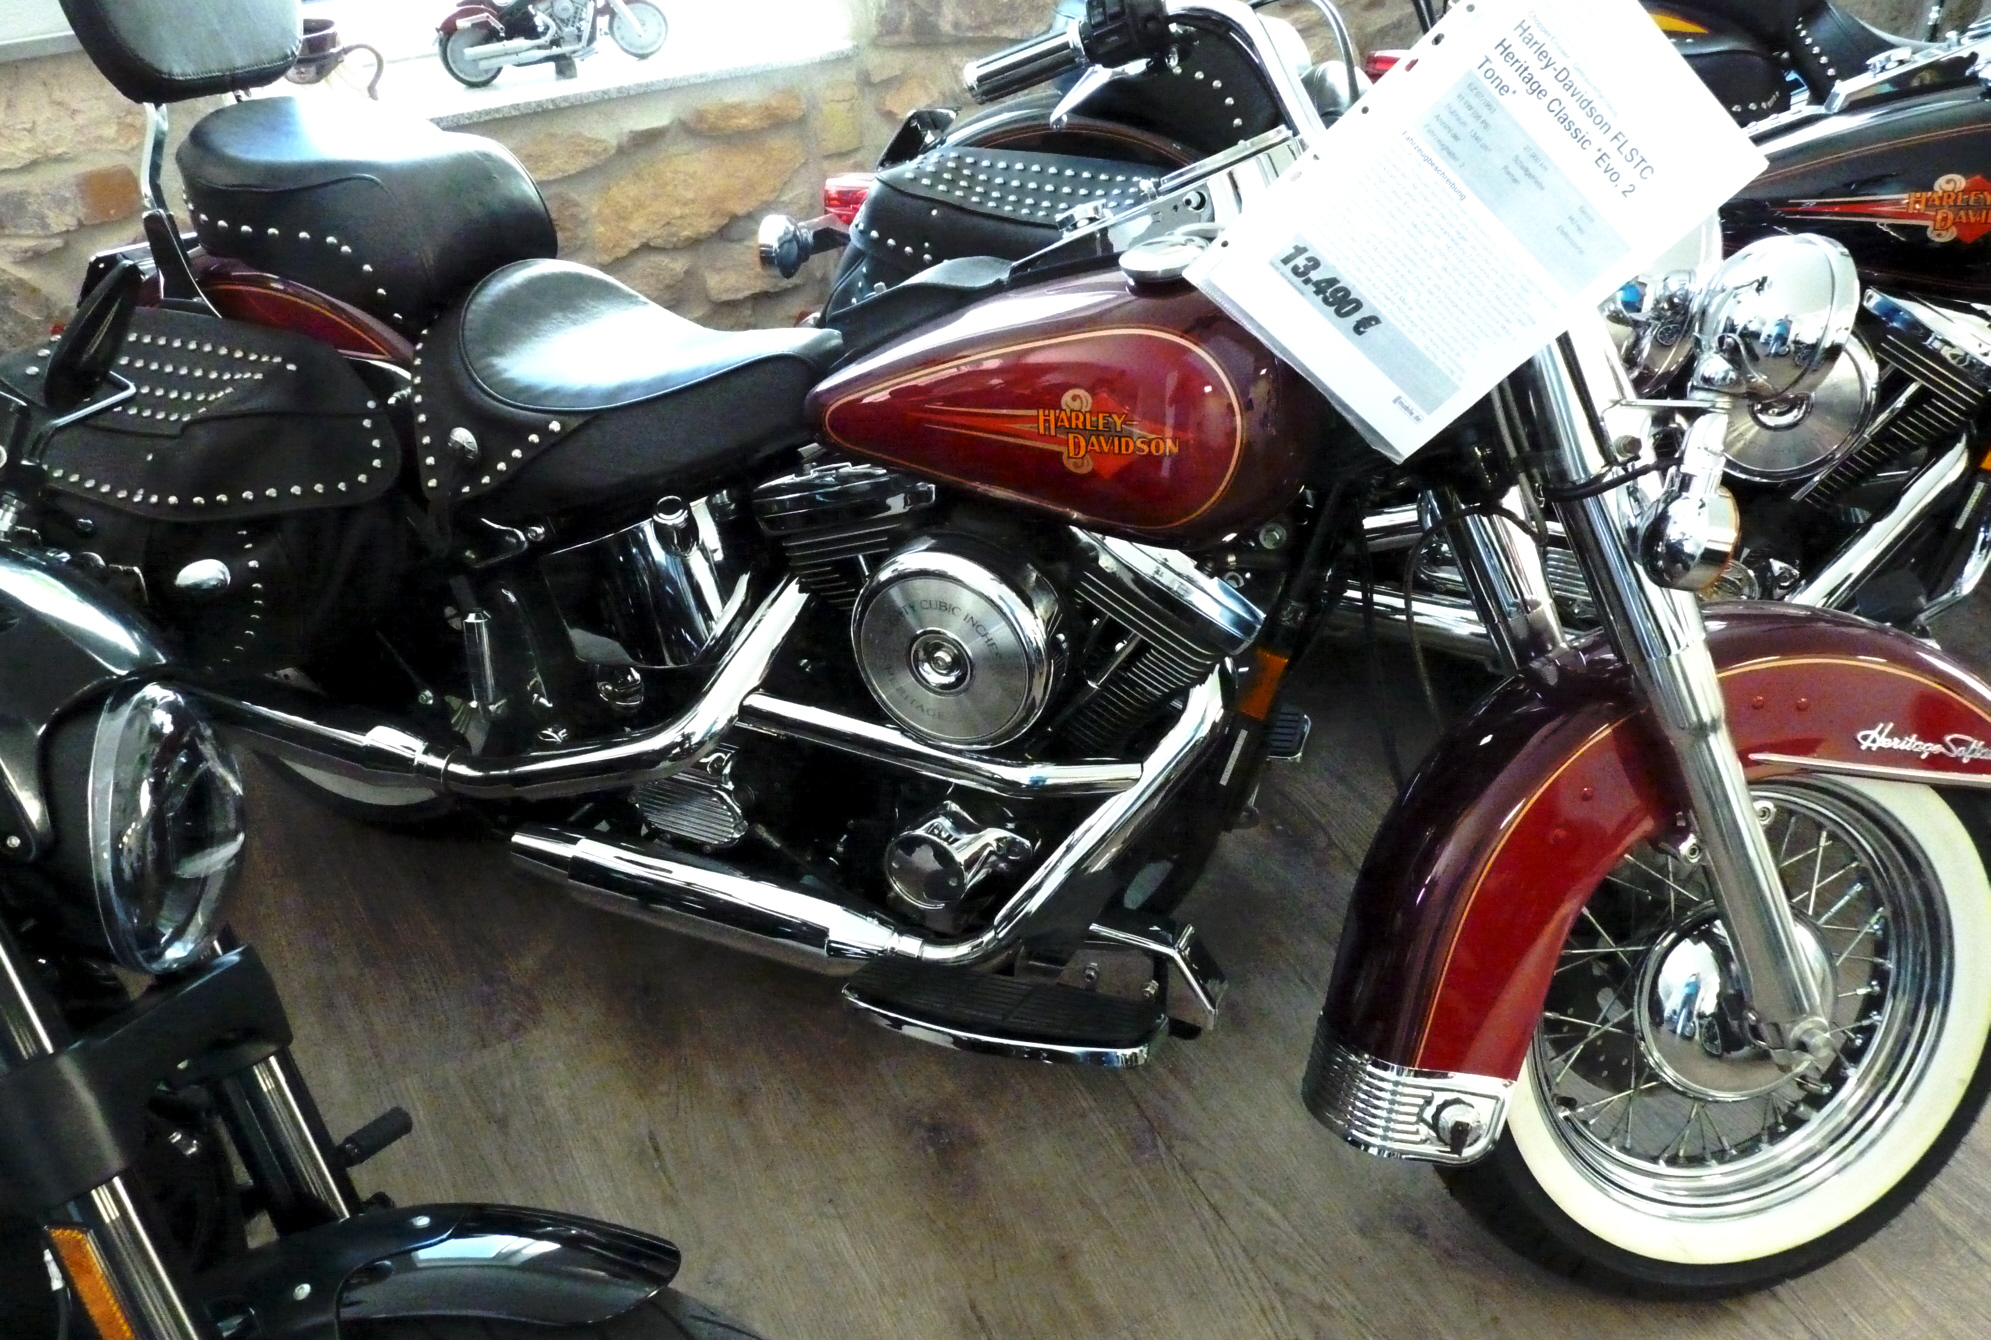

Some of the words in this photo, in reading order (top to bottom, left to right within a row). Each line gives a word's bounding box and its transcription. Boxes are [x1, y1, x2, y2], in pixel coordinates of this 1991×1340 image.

[1493, 37, 1548, 101] Heritage
[1546, 97, 1592, 151] Classic
[1620, 183, 1636, 198] 2
[1513, 18, 1612, 135] Harley-Davidson
[1609, 130, 1655, 180] FLSTC
[1402, 130, 1467, 202] Fahrzeugbeschreibung
[1280, 246, 1364, 319] 13.490
[1352, 314, 1382, 337] €
[1067, 432, 1179, 459] DAVIDSON
[920, 598, 962, 617] CUBIC
[963, 612, 1004, 661] INCHES
[1856, 722, 1944, 759] Heritage
